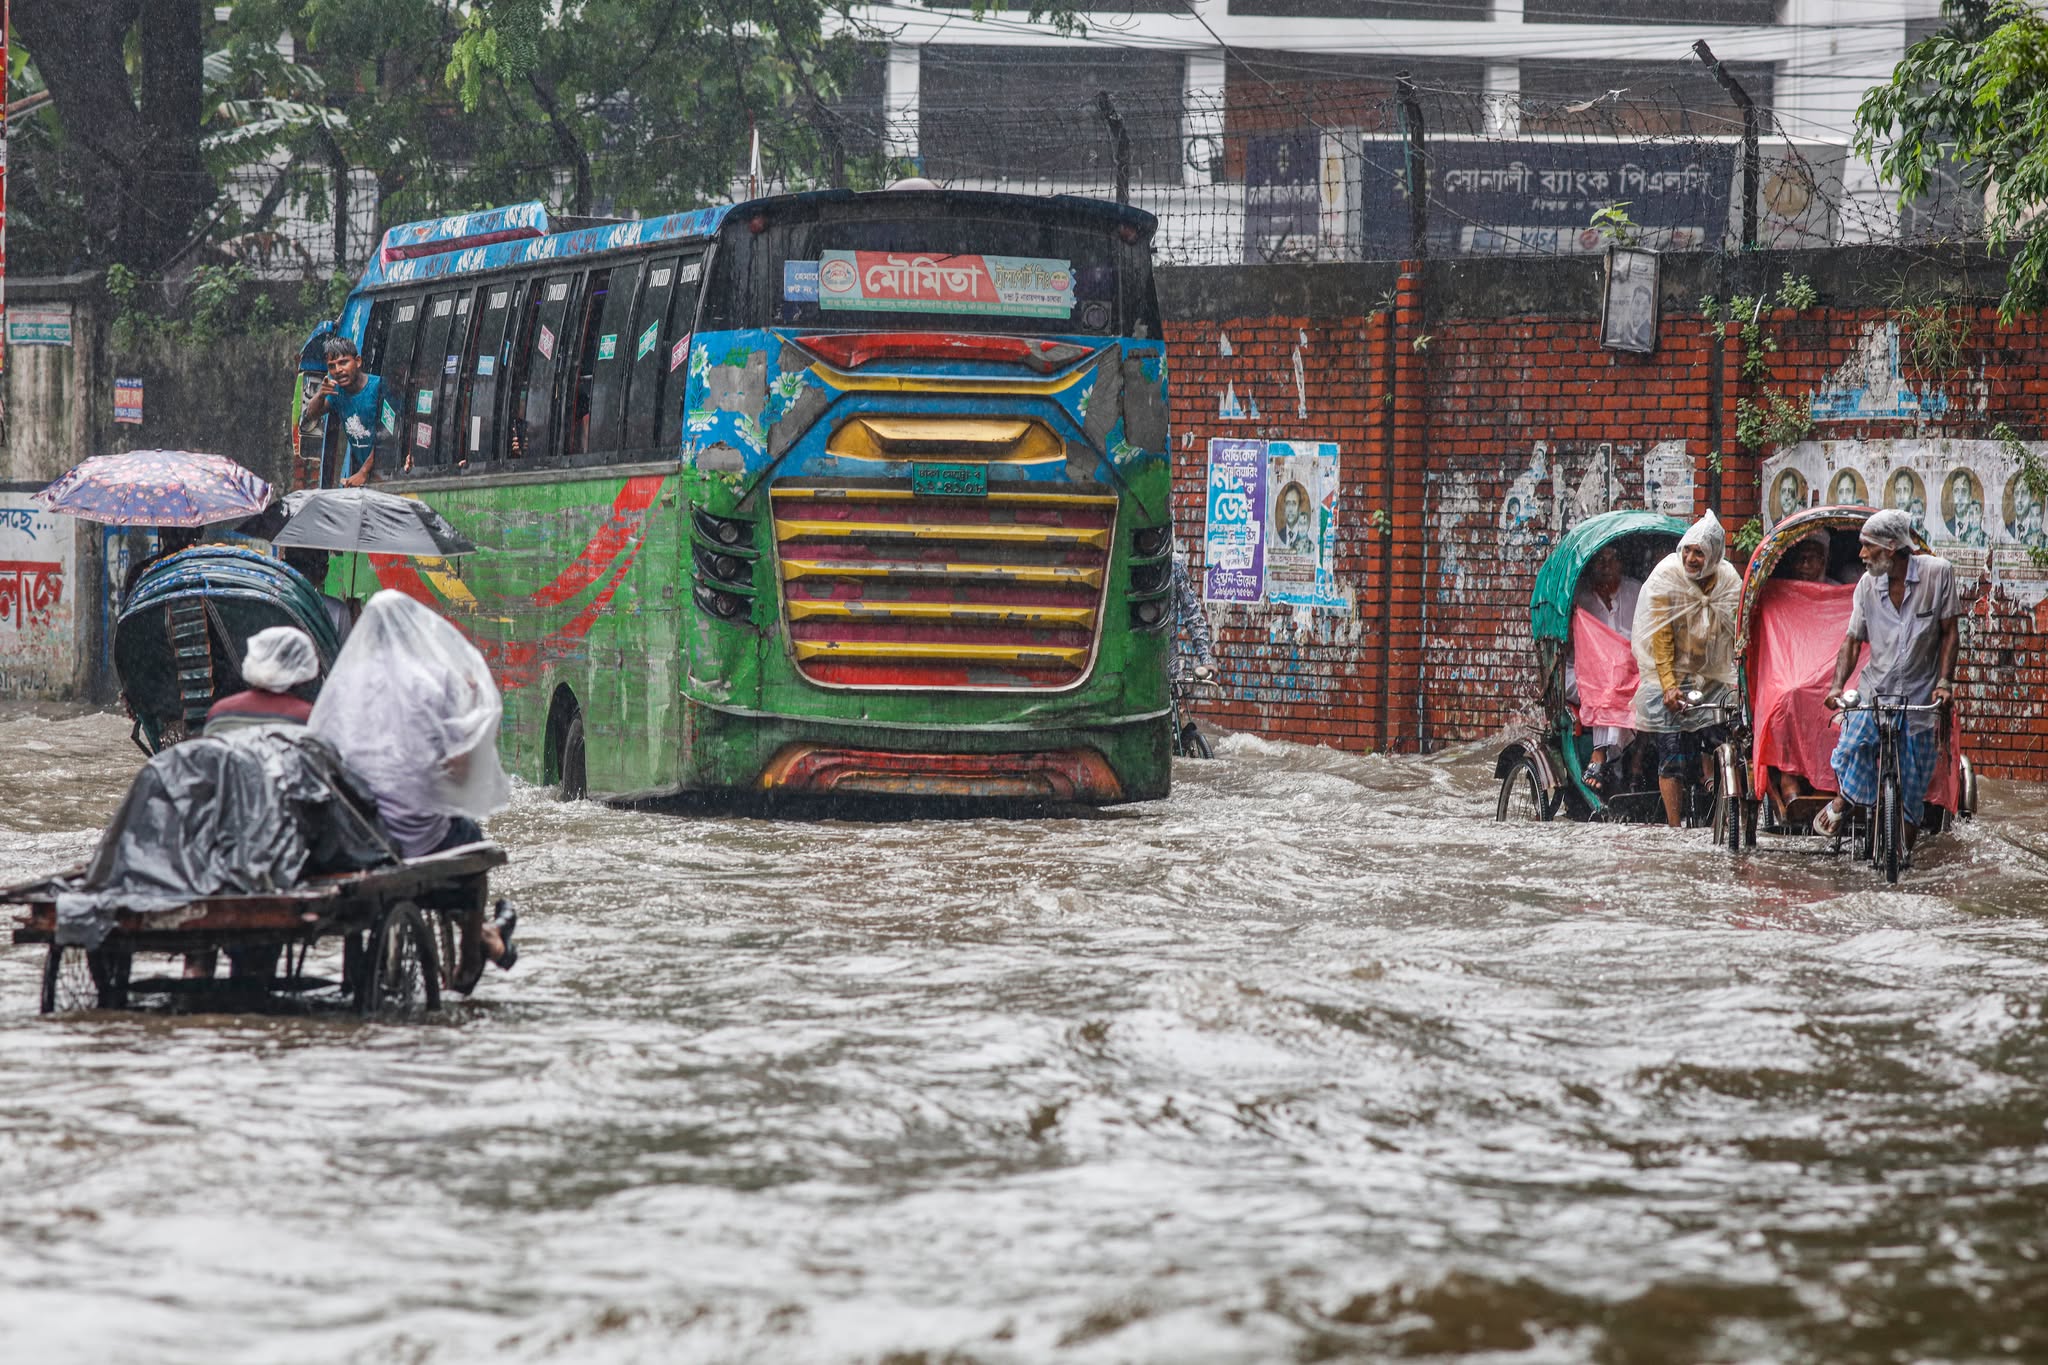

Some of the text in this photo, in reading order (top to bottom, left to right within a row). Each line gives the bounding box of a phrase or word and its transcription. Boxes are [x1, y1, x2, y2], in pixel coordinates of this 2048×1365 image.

[1445, 161, 1533, 192] সোনালী
[1540, 170, 1610, 195] ব্যাংক
[1521, 231, 1557, 246] VISA
[865, 253, 984, 298] মৌমিতা
[1222, 444, 1258, 462] মেডিকেল
